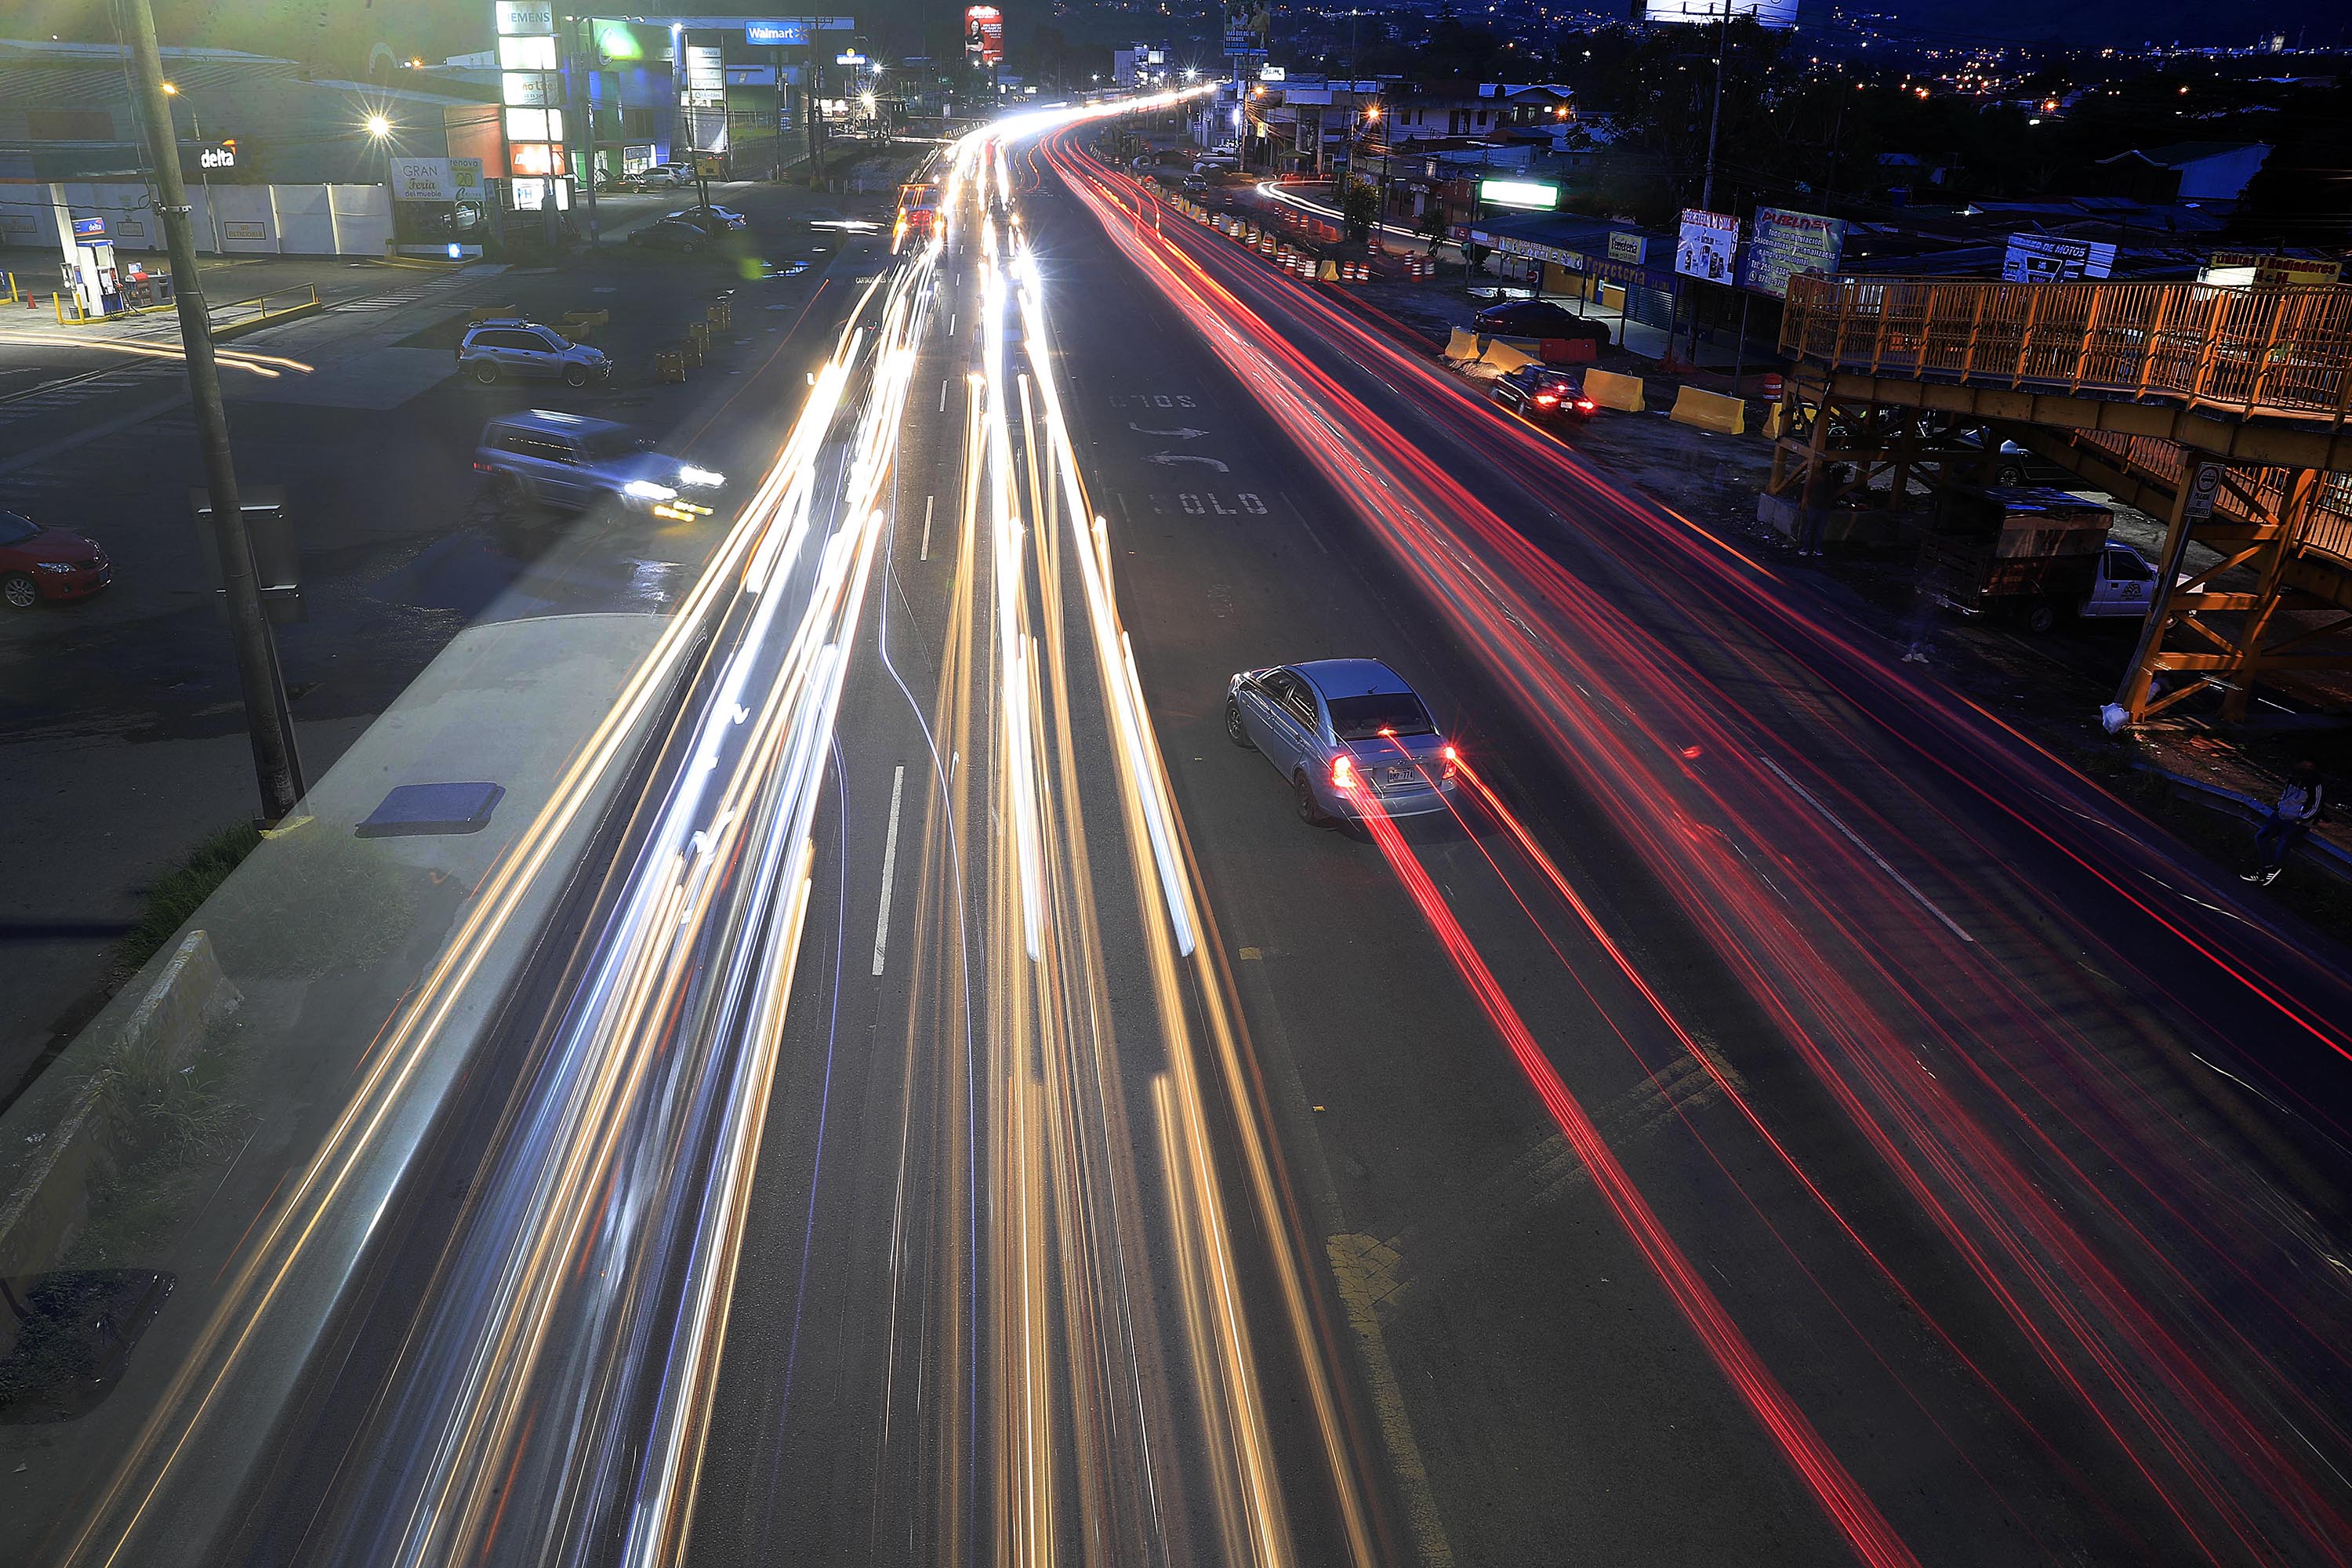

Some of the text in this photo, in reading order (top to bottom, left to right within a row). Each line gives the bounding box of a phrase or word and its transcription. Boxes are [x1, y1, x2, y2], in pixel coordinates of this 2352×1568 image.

[749, 27, 793, 38] Walmart
[201, 147, 234, 169] delta
[403, 165, 438, 176] GRAN
[408, 178, 437, 190] Feria
[88, 223, 102, 231] delta
[1768, 228, 1781, 237] Todo
[1790, 244, 1836, 260] Personalizadas
[2054, 244, 2087, 257] MOTOS
[2267, 257, 2337, 274] Radiadores
